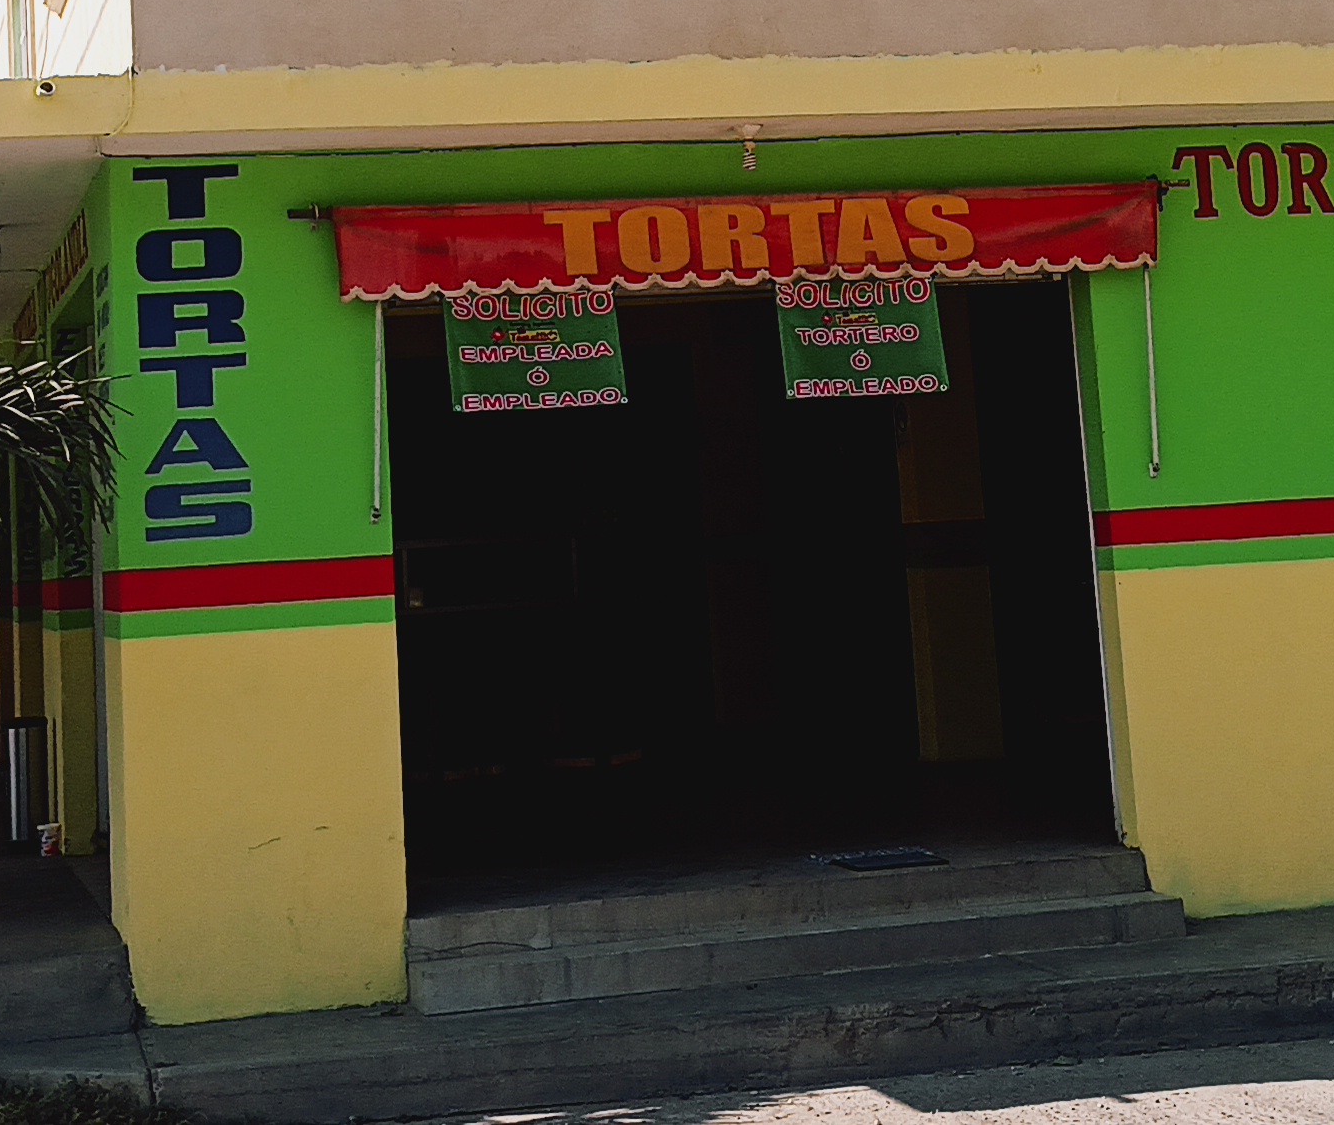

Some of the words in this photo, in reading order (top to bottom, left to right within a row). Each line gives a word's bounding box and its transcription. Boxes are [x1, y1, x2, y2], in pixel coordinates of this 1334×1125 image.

[543, 194, 975, 275] TORTAS
[450, 290, 614, 320] SOLICITO
[776, 276, 931, 308] SOLICITO
[795, 323, 919, 346] TORTERO
[132, 164, 253, 542] TORTAS
[459, 341, 614, 363] EMPLEADA
[462, 387, 621, 412] EMPLEADO
[794, 374, 938, 398] EMPLEADO
